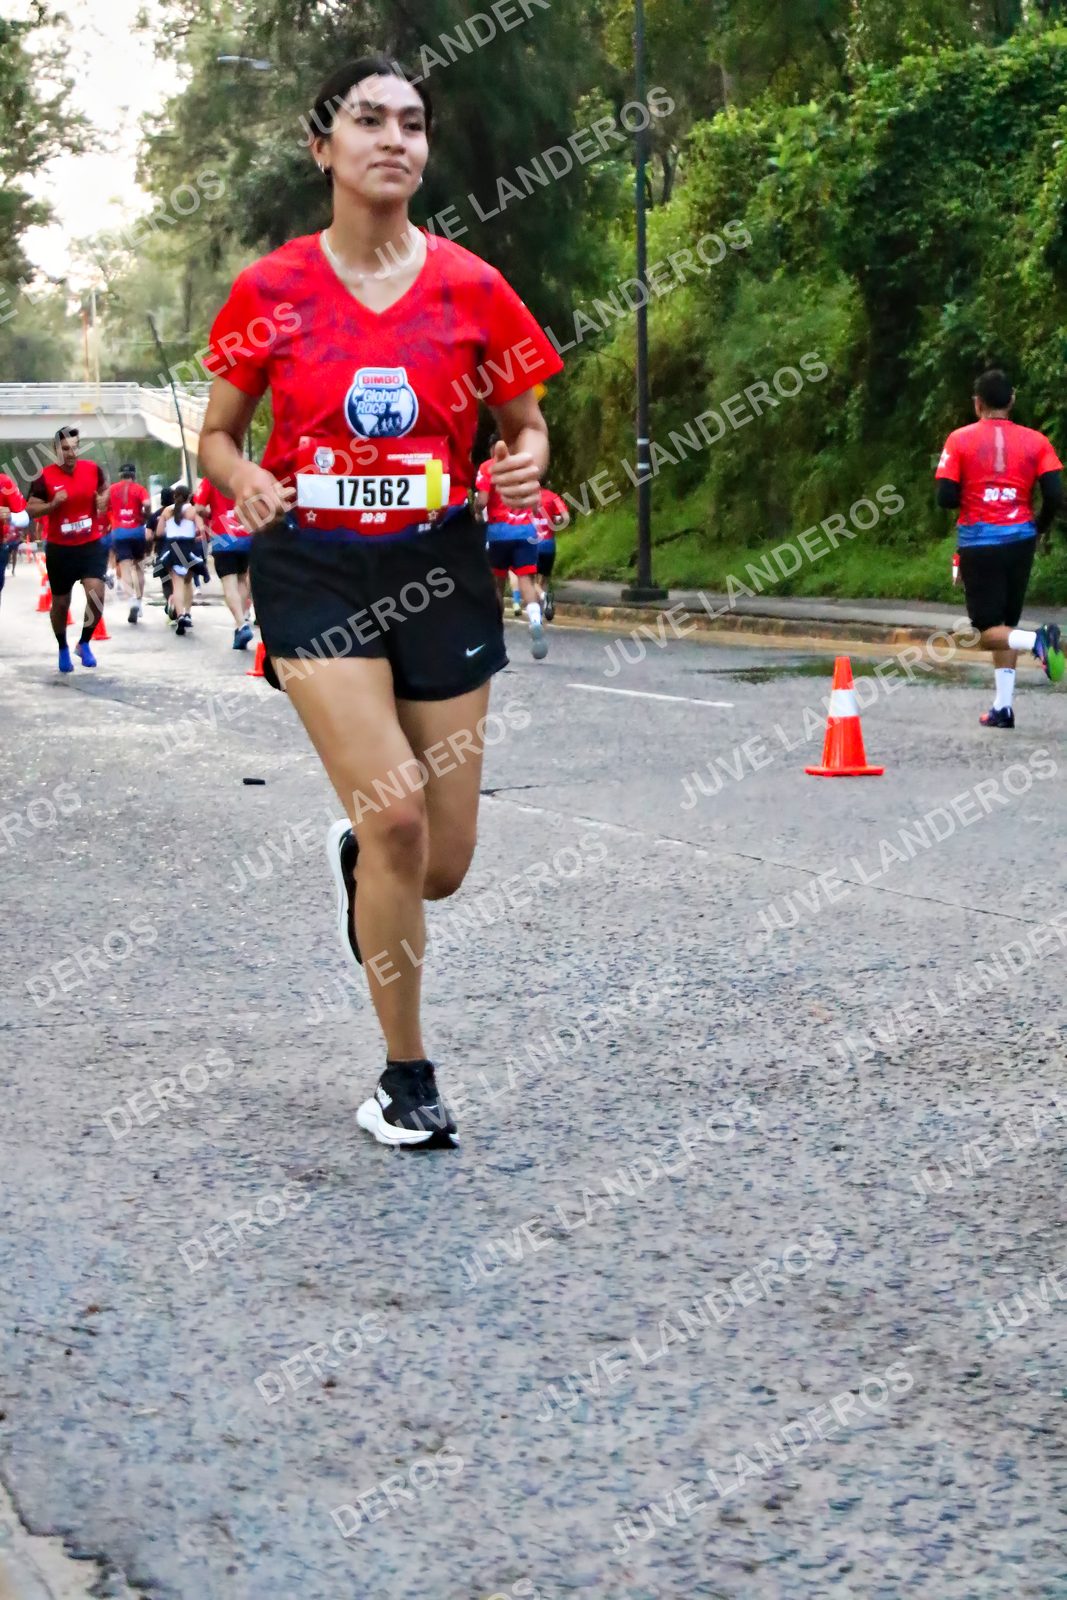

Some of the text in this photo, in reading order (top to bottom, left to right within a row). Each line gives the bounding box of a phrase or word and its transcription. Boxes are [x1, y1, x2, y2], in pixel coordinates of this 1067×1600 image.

[362, 376, 400, 384] BIMBO
[363, 389, 400, 403] Global
[356, 400, 387, 414] Race
[336, 477, 410, 506] 17562
